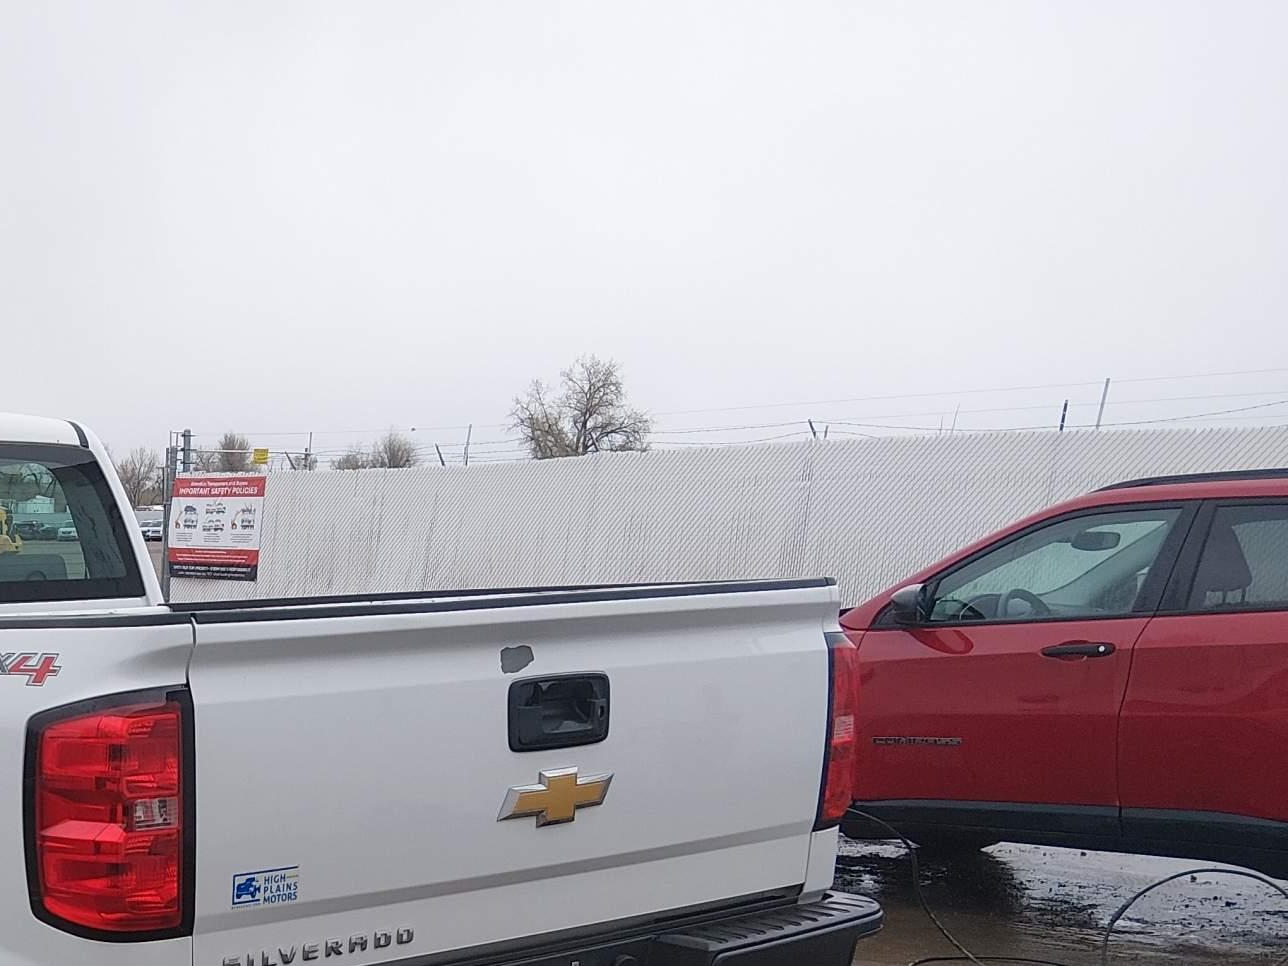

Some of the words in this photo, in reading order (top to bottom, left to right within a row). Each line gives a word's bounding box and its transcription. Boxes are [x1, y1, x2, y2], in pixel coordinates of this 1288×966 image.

[179, 487, 210, 495] IMPORTANT
[211, 487, 232, 495] SAFETY
[232, 486, 259, 495] POLICIES
[263, 873, 287, 886] HIGH
[263, 881, 299, 895] PLAINS
[263, 891, 298, 905] MOTORS
